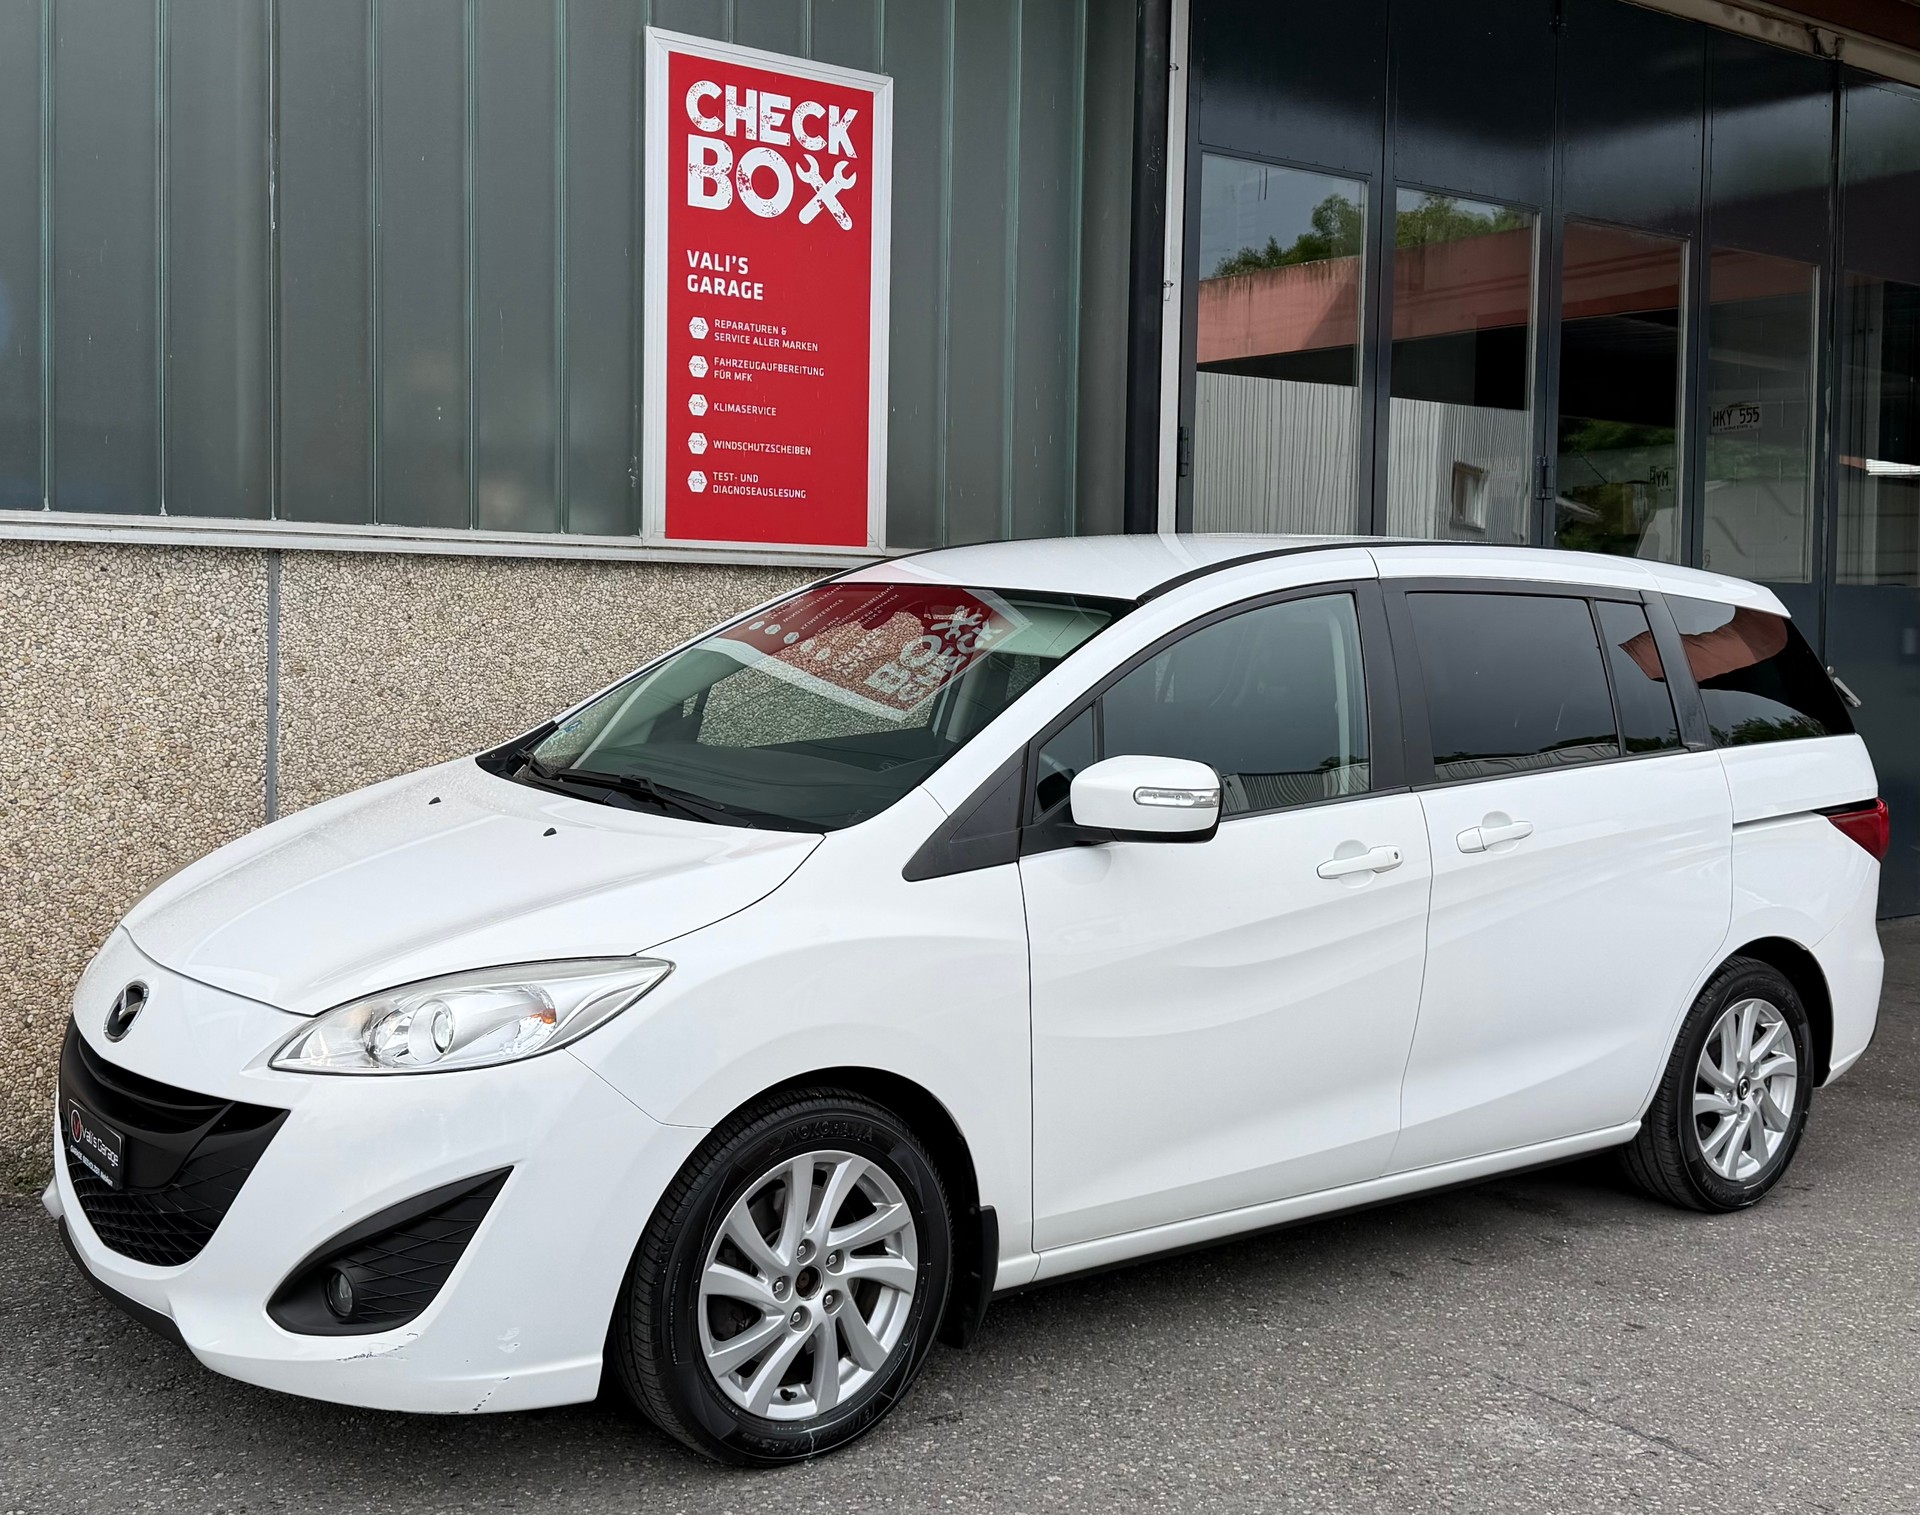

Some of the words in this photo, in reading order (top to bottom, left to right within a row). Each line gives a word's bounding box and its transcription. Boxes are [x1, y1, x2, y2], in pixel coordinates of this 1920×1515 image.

[686, 80, 858, 158] CHECK
[687, 134, 857, 231] BOX
[686, 250, 749, 274] VALI'S
[687, 274, 764, 300] GARAGE
[714, 319, 778, 334] REPARATUREN
[782, 327, 787, 336] &
[714, 332, 750, 344] SERVICE
[753, 337, 780, 348] ALLER
[782, 340, 818, 352] MARKEN
[714, 357, 825, 376] FAHRZEUGAUFBEREITUNG
[714, 370, 732, 380] FÜR
[734, 372, 752, 382] MFK
[714, 403, 776, 416] KLIMASERVICE
[1712, 409, 1733, 427] HKY
[1739, 406, 1760, 424] 555
[713, 440, 812, 456] WINDSCHUTZSCHEIBEN
[712, 472, 738, 481] TEST-
[740, 474, 759, 483] UND
[712, 485, 806, 498] DIAGNOSEAUSLESUNG
